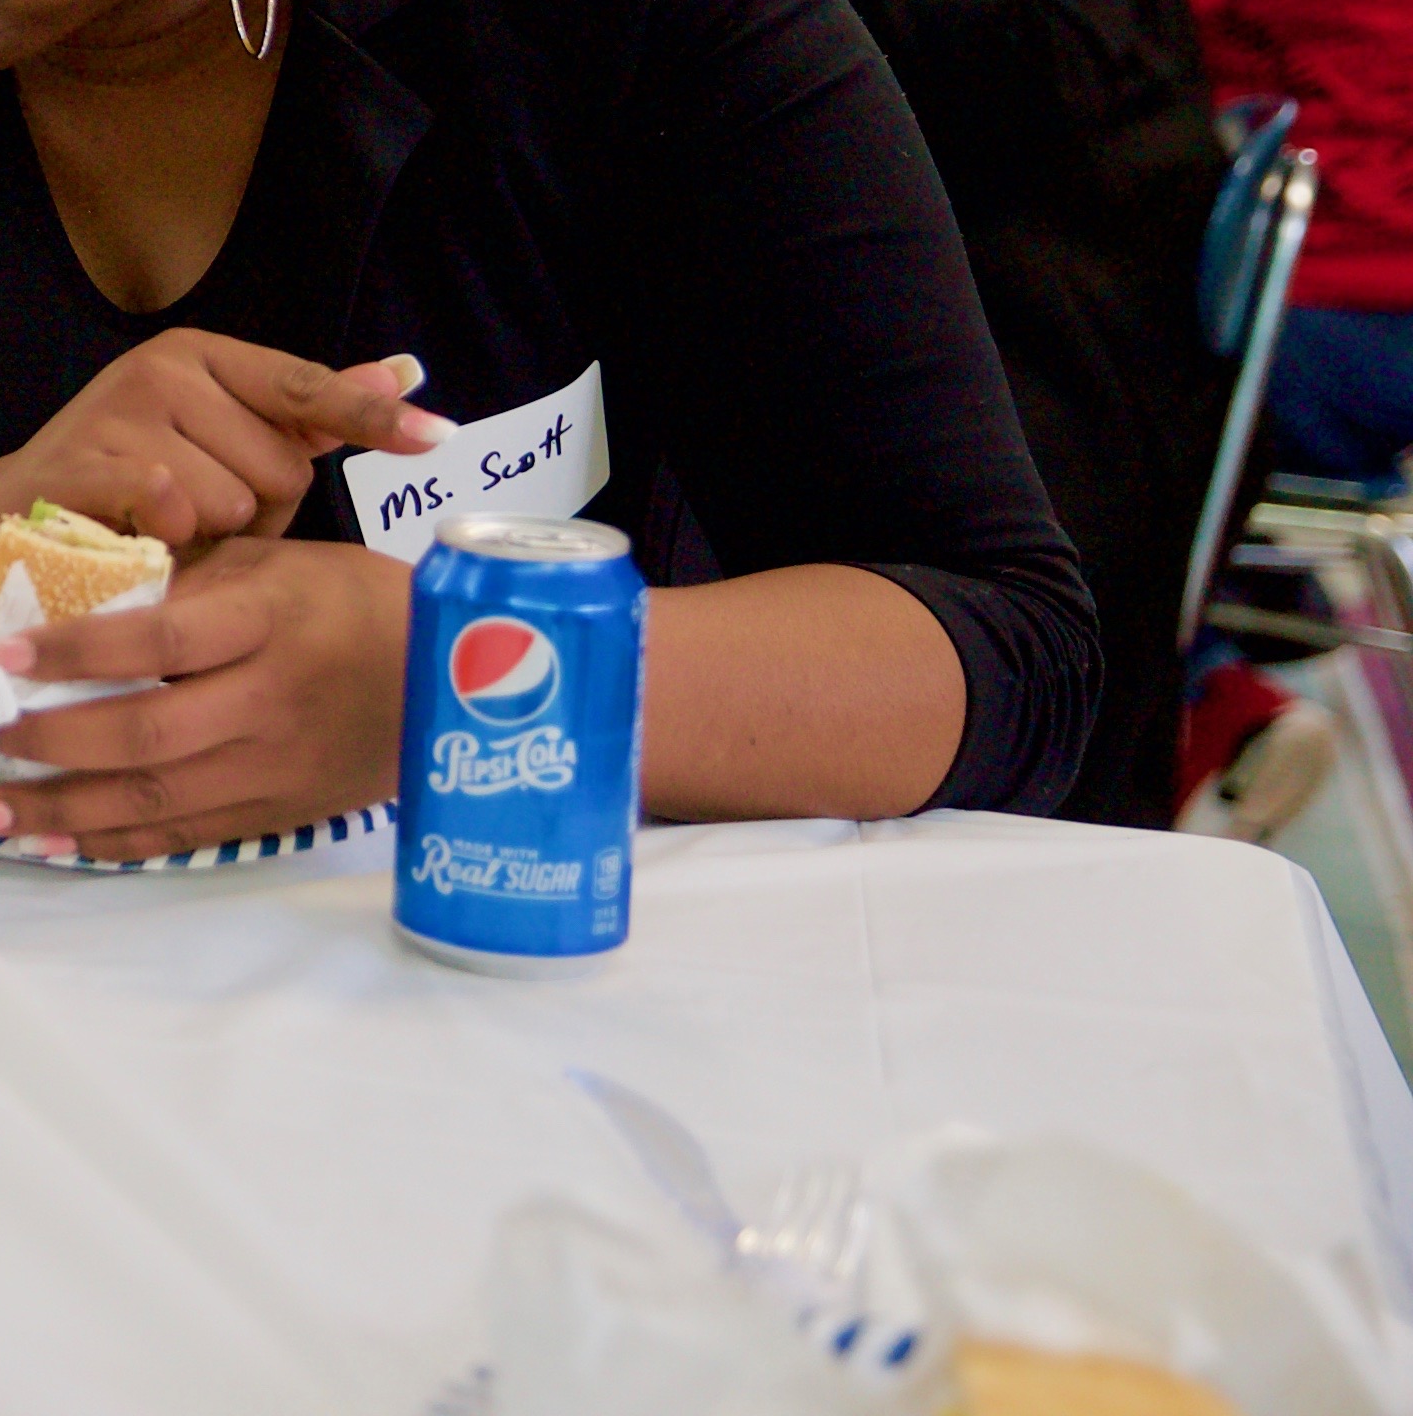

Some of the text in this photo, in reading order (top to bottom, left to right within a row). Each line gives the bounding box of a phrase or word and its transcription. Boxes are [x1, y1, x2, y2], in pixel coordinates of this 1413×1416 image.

[480, 413, 573, 491] Scott
[412, 834, 582, 896] Real SUGAR
